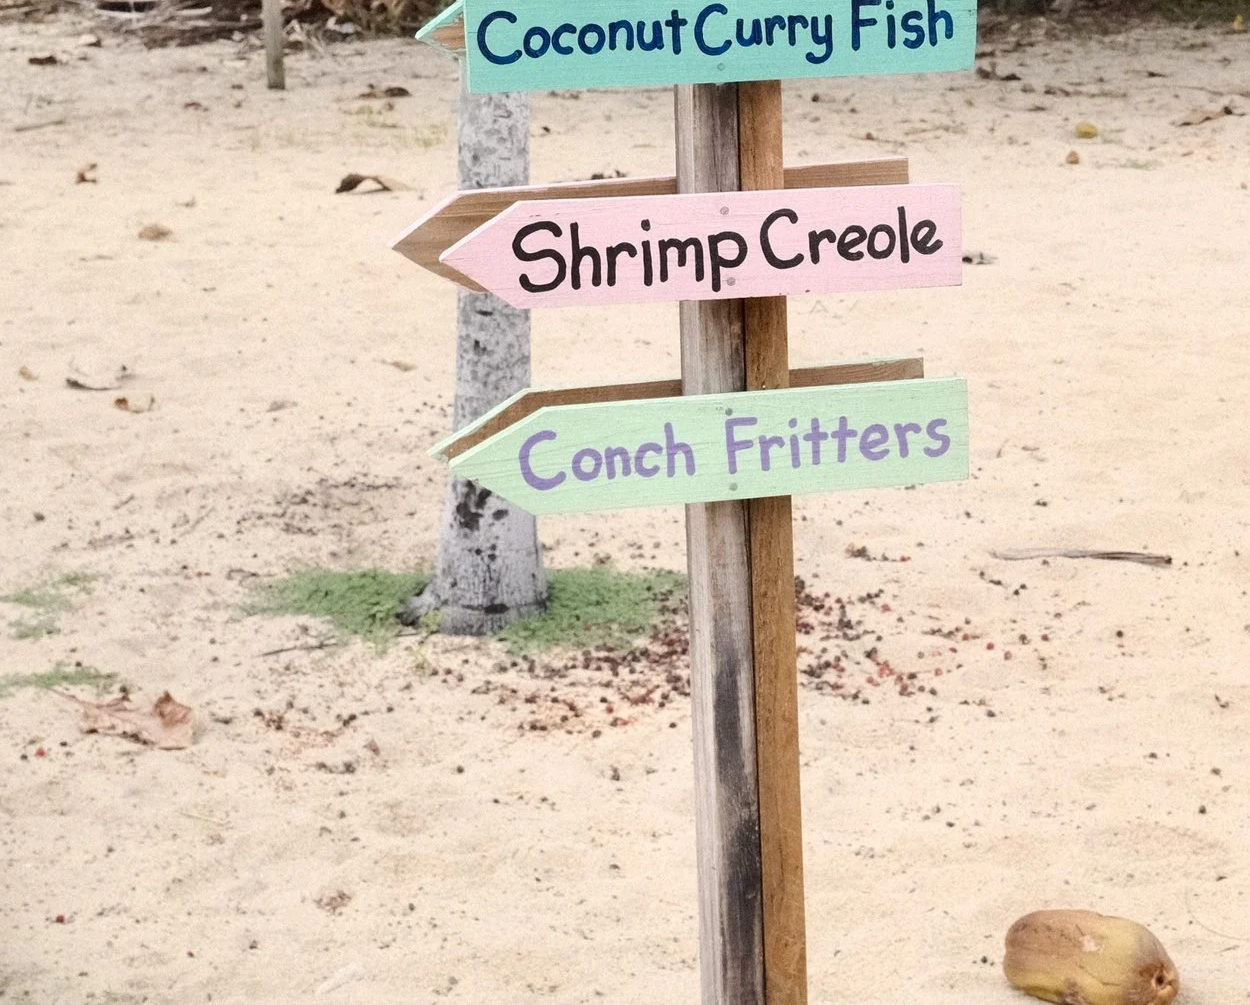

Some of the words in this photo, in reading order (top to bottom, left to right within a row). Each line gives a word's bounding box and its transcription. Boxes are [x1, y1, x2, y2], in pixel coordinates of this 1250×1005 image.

[476, 9, 688, 65] Coconut
[693, 3, 834, 65] Curry
[511, 219, 748, 293] Shrimp
[759, 206, 943, 270] Creole
[518, 422, 697, 491] Conch
[725, 417, 951, 474] Fritters
